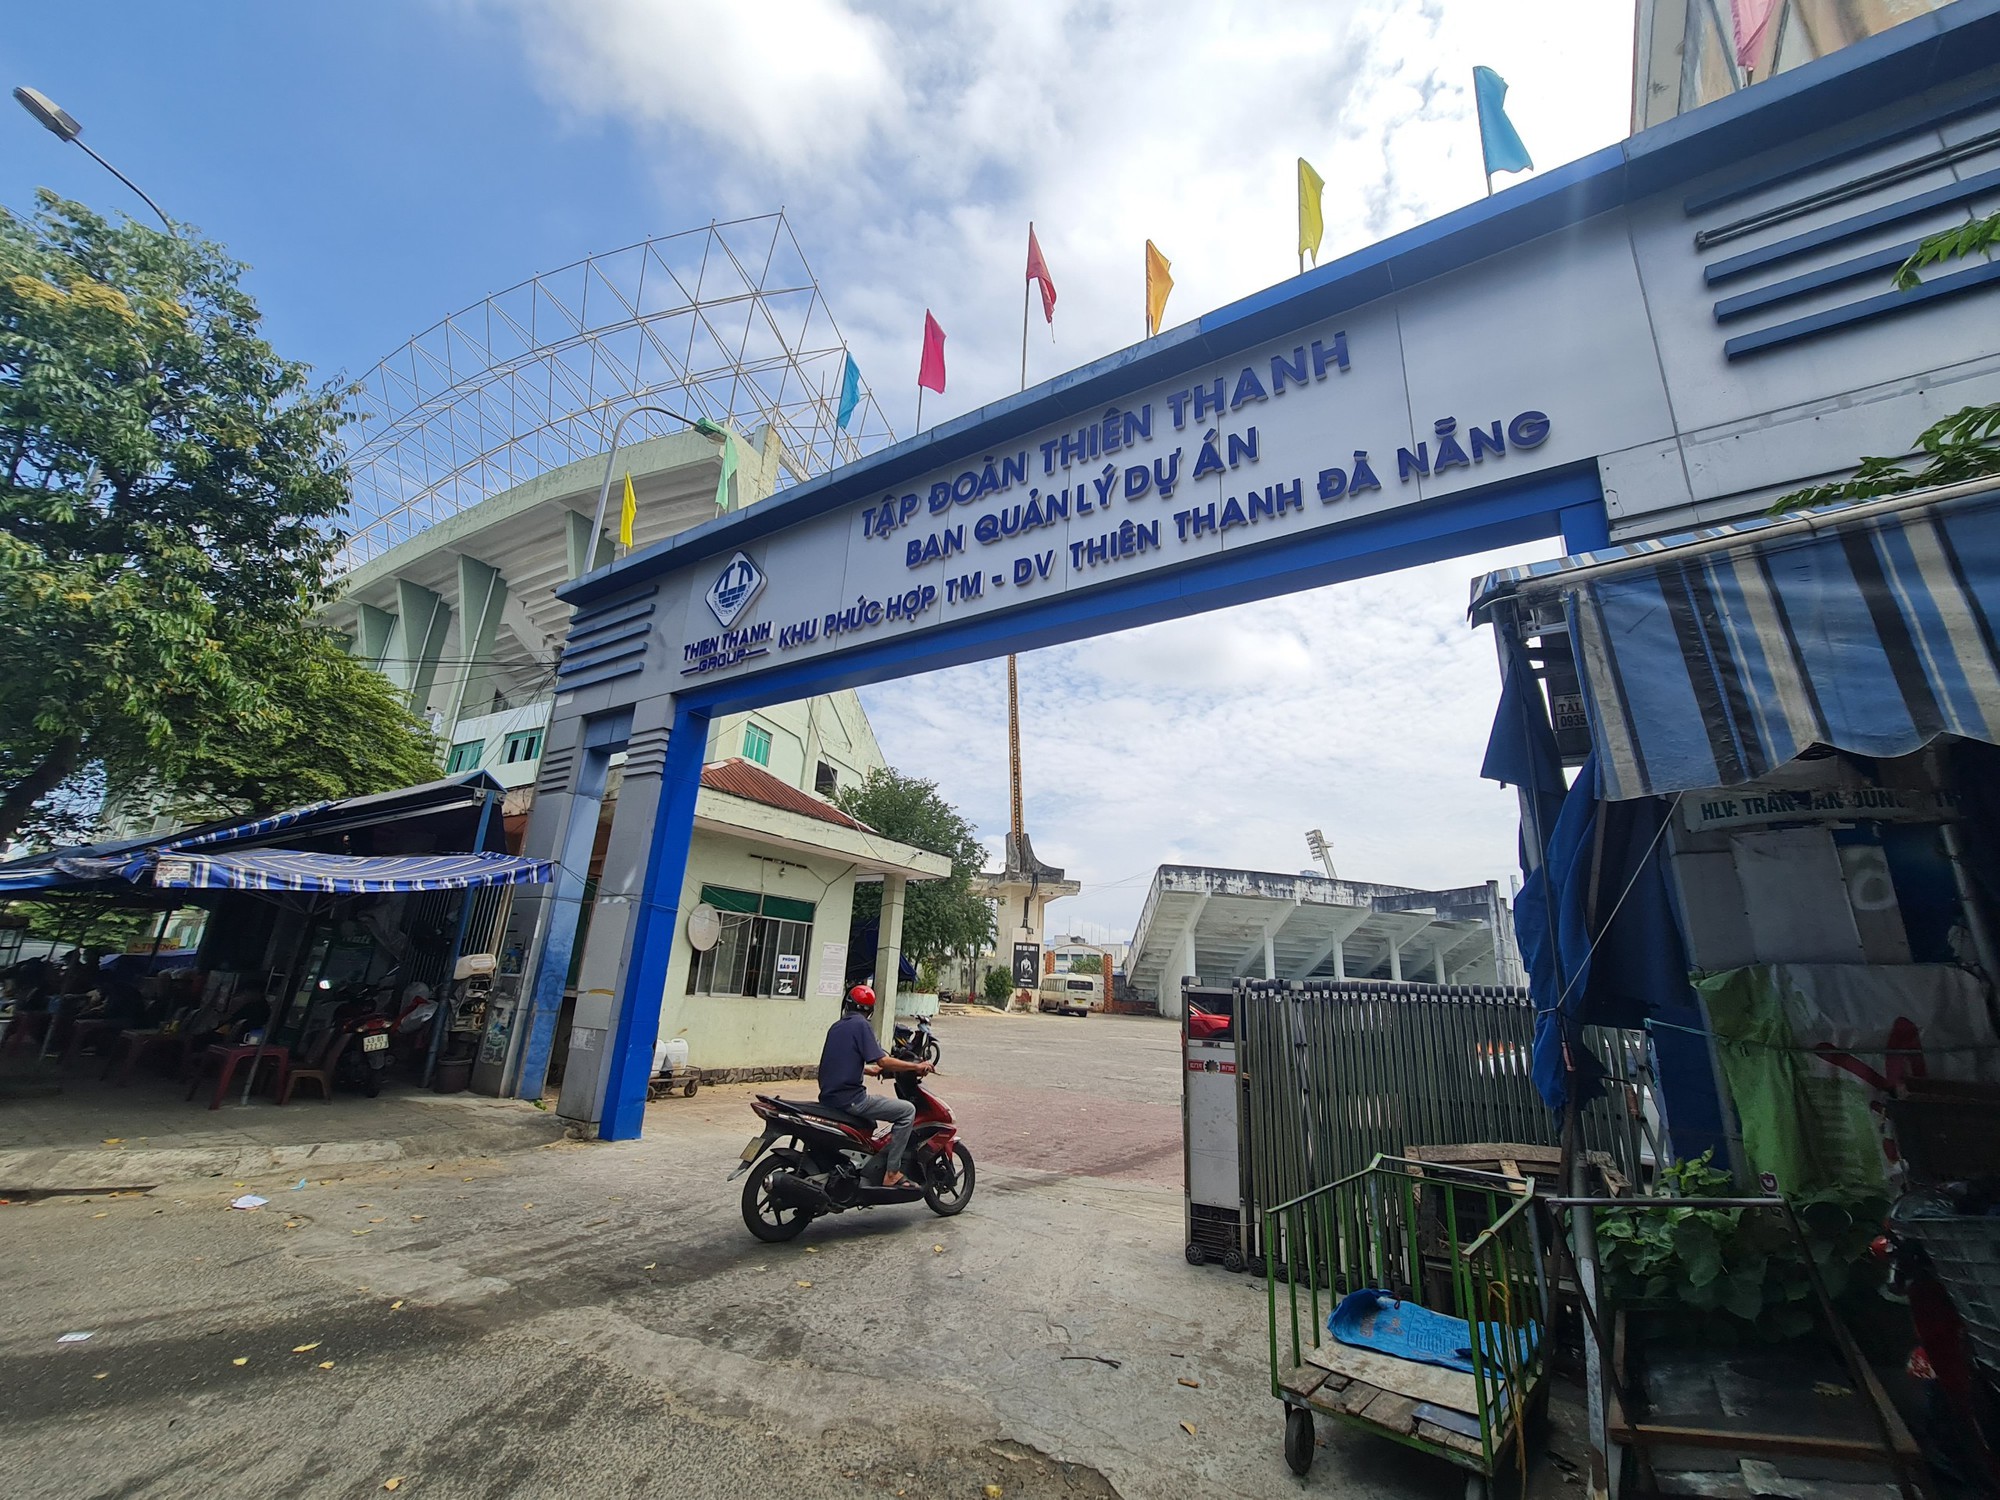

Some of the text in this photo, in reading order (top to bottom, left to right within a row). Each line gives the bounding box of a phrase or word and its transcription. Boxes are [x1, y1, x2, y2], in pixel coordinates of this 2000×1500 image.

[862, 330, 1351, 539] TẬP ĐOÀN THIÊN THANH
[906, 426, 1260, 568] BAN QUẢN LÝ DỰ ÁN
[778, 617, 820, 650] KHU
[823, 594, 885, 638] PHỨC
[885, 584, 939, 623] HỢP
[945, 571, 985, 604] TM
[1013, 550, 1056, 586] DV
[1070, 518, 1162, 571] THIÊN
[1173, 477, 1304, 541] THANH
[1316, 450, 1382, 506] ĐÀ
[1397, 410, 1552, 483] NẴNG
[698, 648, 748, 673] GROUP
[722, 621, 775, 653] THANH
